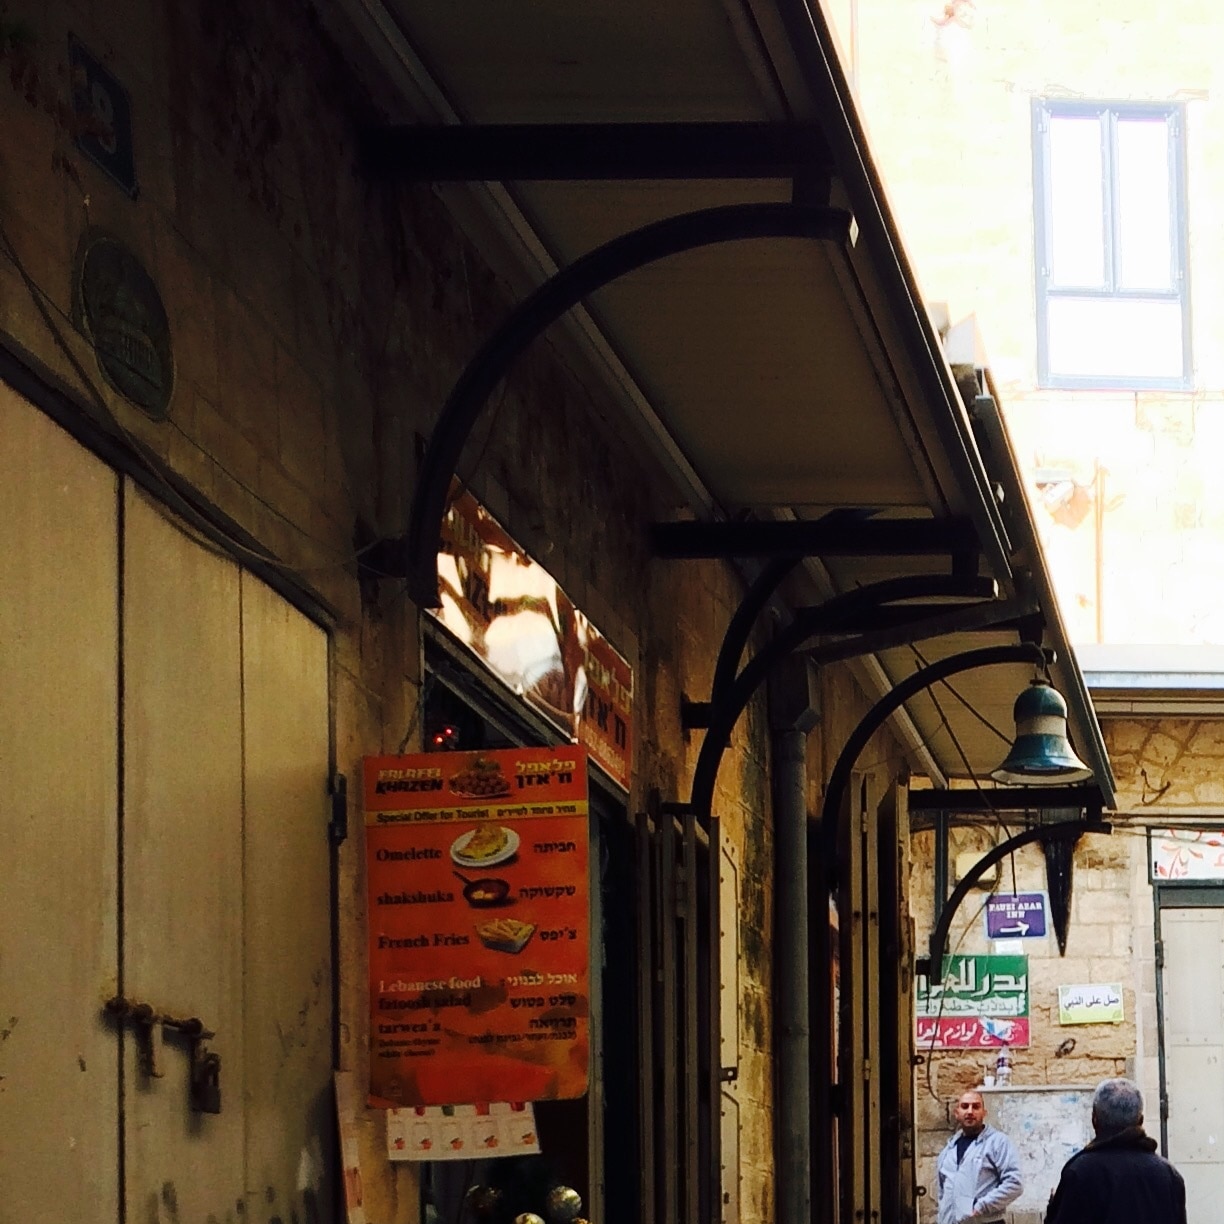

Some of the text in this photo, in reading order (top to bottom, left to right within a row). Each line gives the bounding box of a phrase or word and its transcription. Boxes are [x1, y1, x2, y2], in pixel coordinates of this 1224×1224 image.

[515, 759, 576, 772] פלאפל
[379, 768, 442, 779] FALAFEL
[515, 772, 572, 788] ח'אזן
[376, 779, 443, 795] KHAZEN
[376, 808, 489, 823] Special Offer for Tourist
[556, 804, 576, 813] מחיר
[376, 847, 442, 861] Omelette
[533, 842, 576, 853] חביתה
[377, 890, 454, 905] shakshuka
[519, 885, 576, 900] שקשוקה
[1006, 911, 1025, 919] INN
[378, 933, 470, 949] French Fries
[540, 926, 576, 941] צ'יפס
[379, 975, 481, 993] Lebanese food
[507, 972, 578, 987] אוכל לבנוני
[548, 993, 576, 1006] סלט
[1064, 994, 1119, 1011] صل على النبي
[943, 1022, 978, 1046] لوازم
